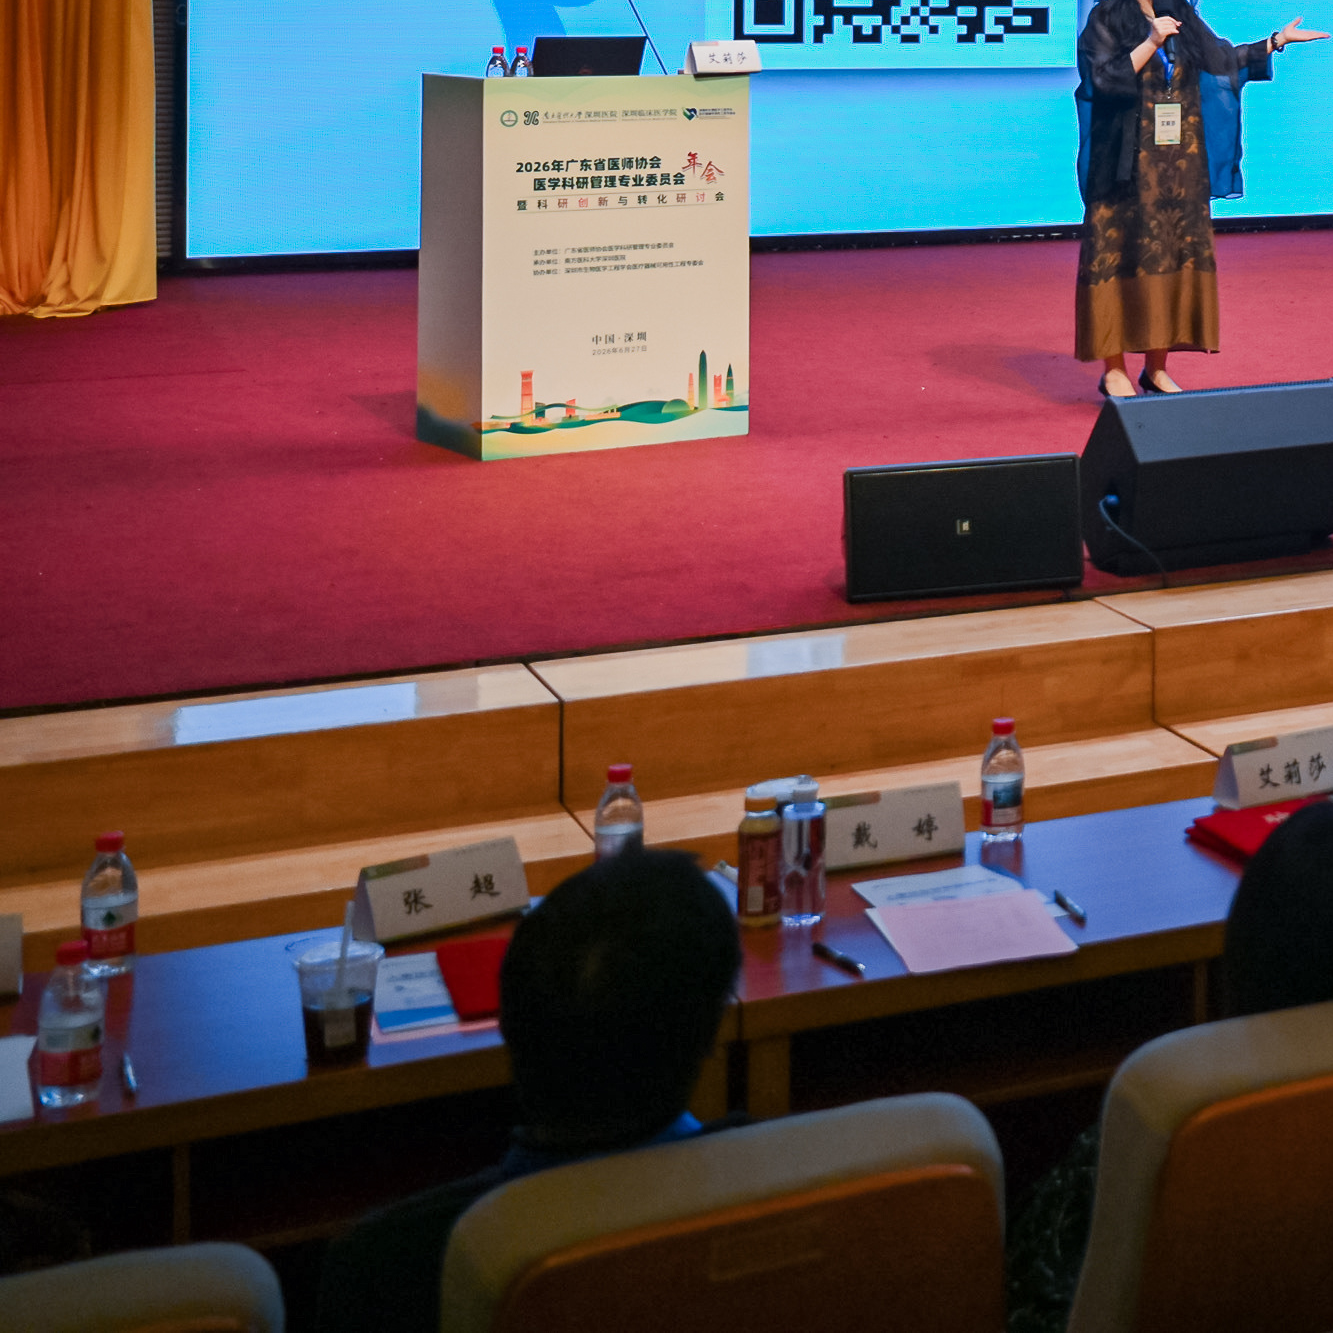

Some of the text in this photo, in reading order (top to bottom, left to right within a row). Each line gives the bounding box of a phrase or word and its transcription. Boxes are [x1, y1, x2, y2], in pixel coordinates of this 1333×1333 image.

[515, 155, 662, 173] 2026年广东省医师协会
[682, 151, 725, 184] 年会
[533, 172, 686, 191] 医学科研管理专业委员会
[516, 191, 725, 211] 暨科研创新与转化研讨会
[1259, 752, 1327, 789] 艾莉莎
